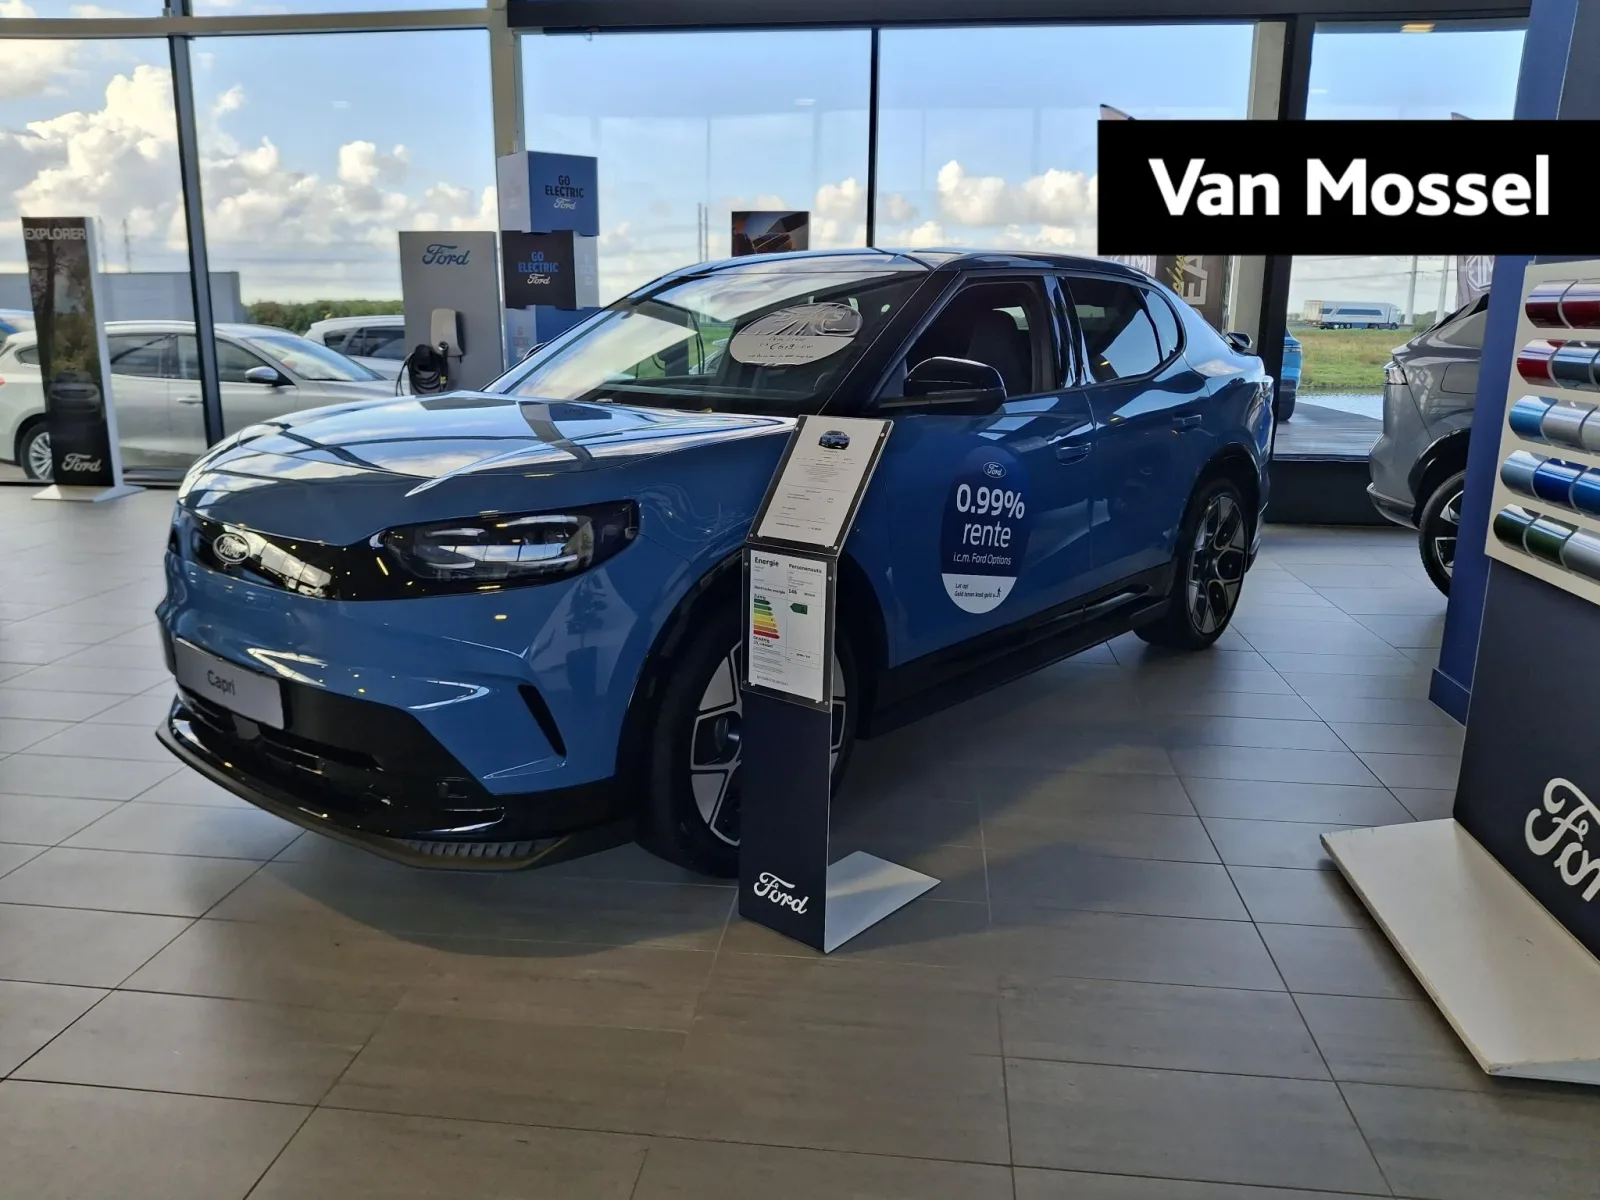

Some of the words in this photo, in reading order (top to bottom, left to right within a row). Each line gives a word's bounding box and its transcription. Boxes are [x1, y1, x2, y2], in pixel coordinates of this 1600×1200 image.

[558, 175, 571, 186] GO
[545, 185, 584, 198] ELECTRIC
[553, 197, 576, 210] Ford
[24, 228, 86, 240] EXPLORER
[422, 244, 470, 265] Ford
[531, 252, 544, 261] GO
[518, 262, 559, 273] ELECTRIC
[527, 273, 551, 285] Ford
[62, 453, 102, 472] Ford
[986, 463, 1003, 476] Ford
[957, 484, 1025, 519] 0.99%
[962, 521, 1011, 548] rente
[754, 557, 779, 568] Energie
[972, 553, 987, 564] Ford
[987, 554, 1012, 566] Options
[788, 564, 822, 574] Personenauto
[207, 669, 235, 696] Capri
[754, 872, 809, 914] Ford
